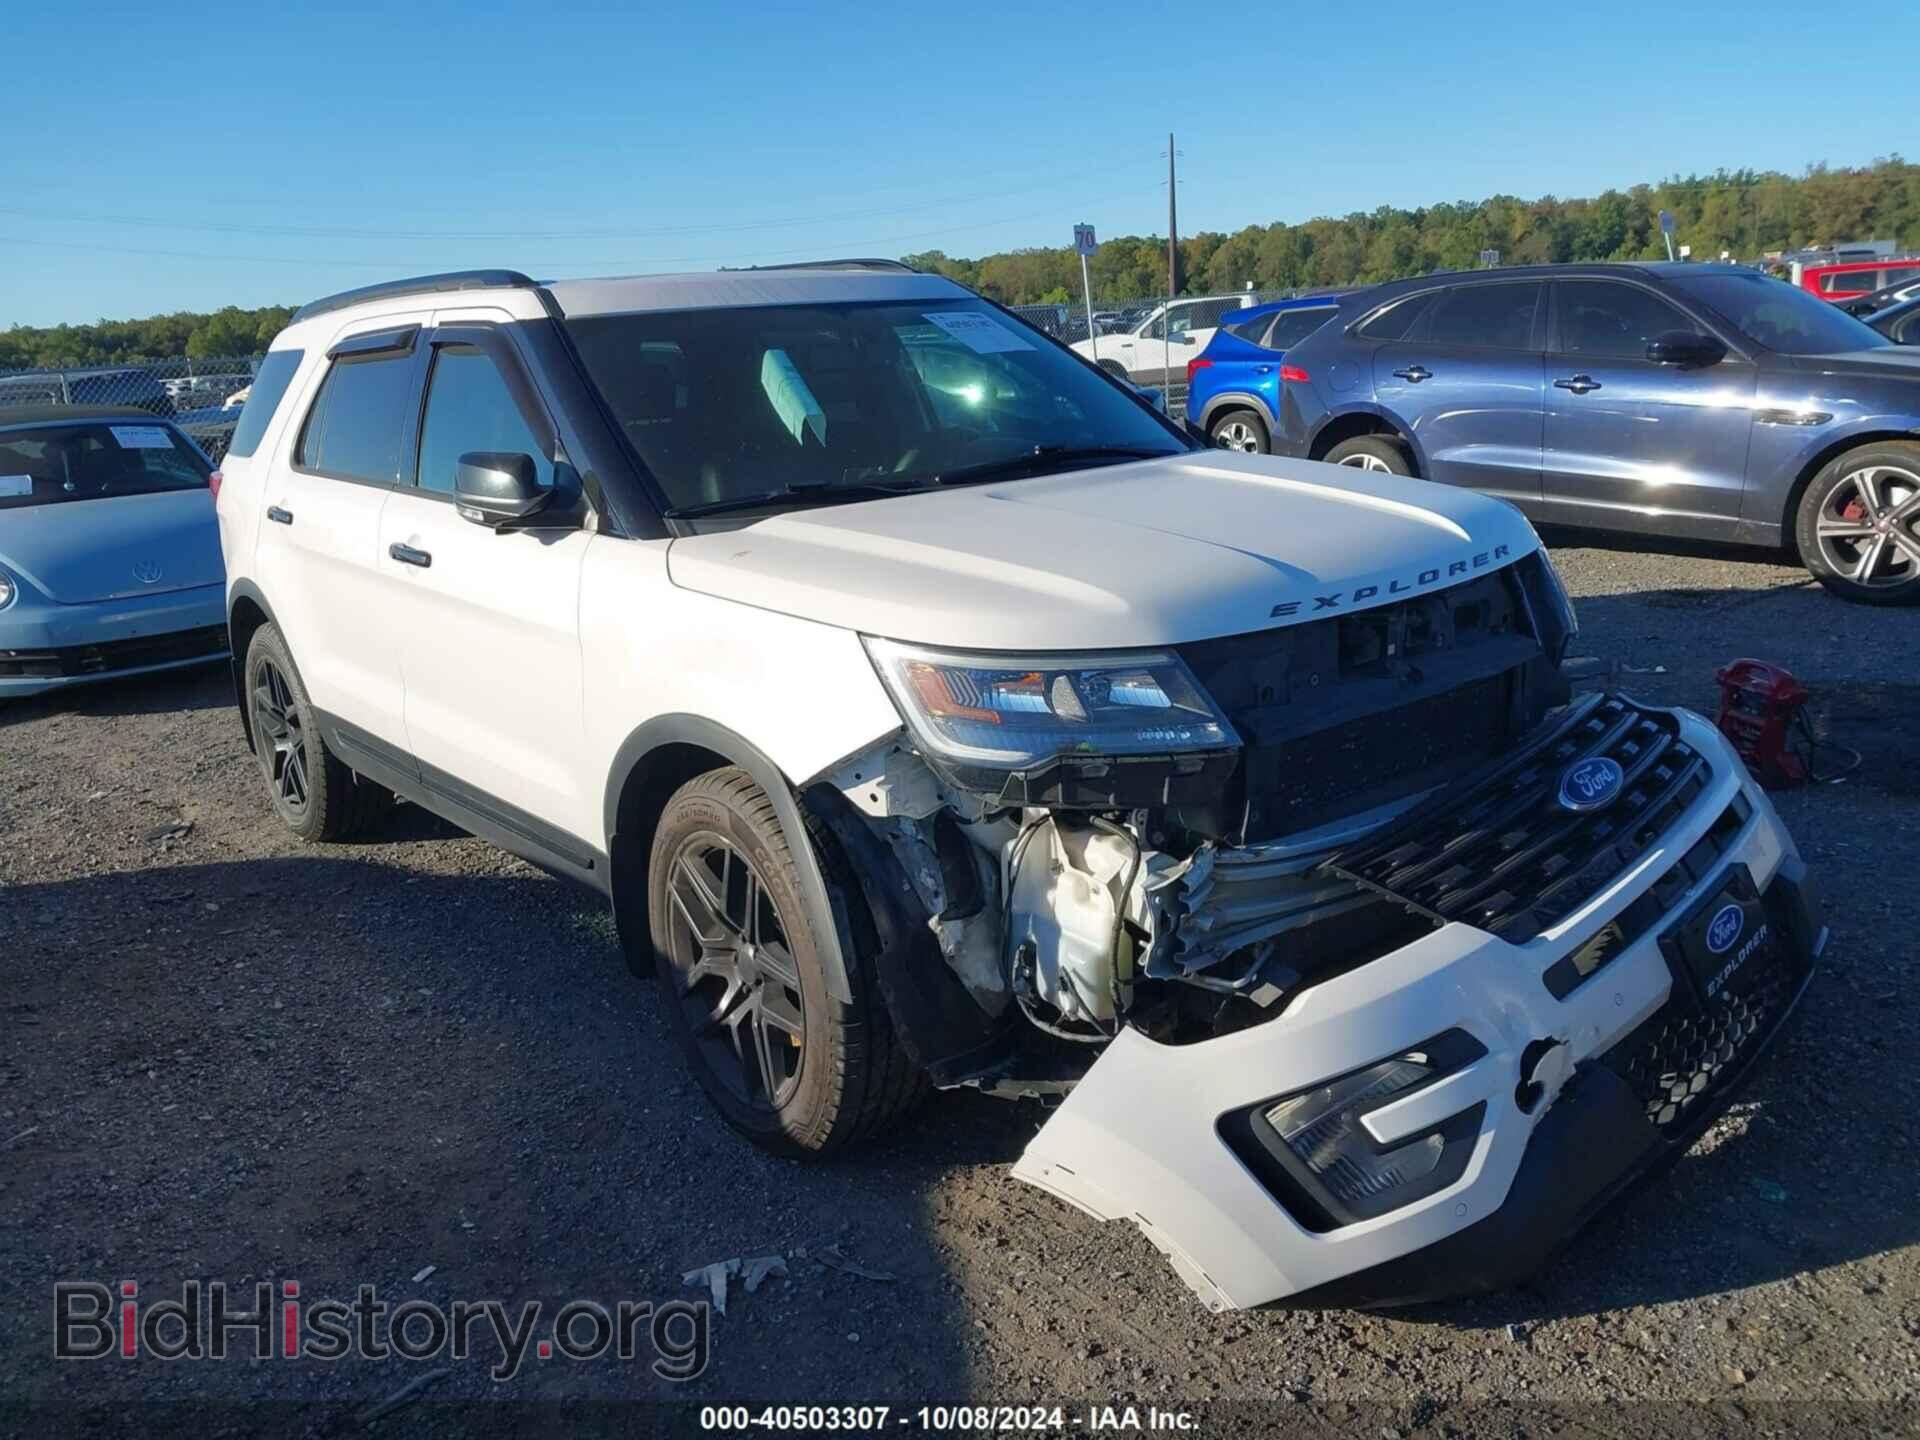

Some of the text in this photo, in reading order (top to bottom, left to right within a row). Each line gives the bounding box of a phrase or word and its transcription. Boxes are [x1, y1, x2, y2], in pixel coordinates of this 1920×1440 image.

[1074, 230, 1096, 249] 70
[1270, 544, 1510, 618] EXPLORER
[1573, 763, 1616, 797] Ford
[1707, 923, 1768, 998] EXPLORER
